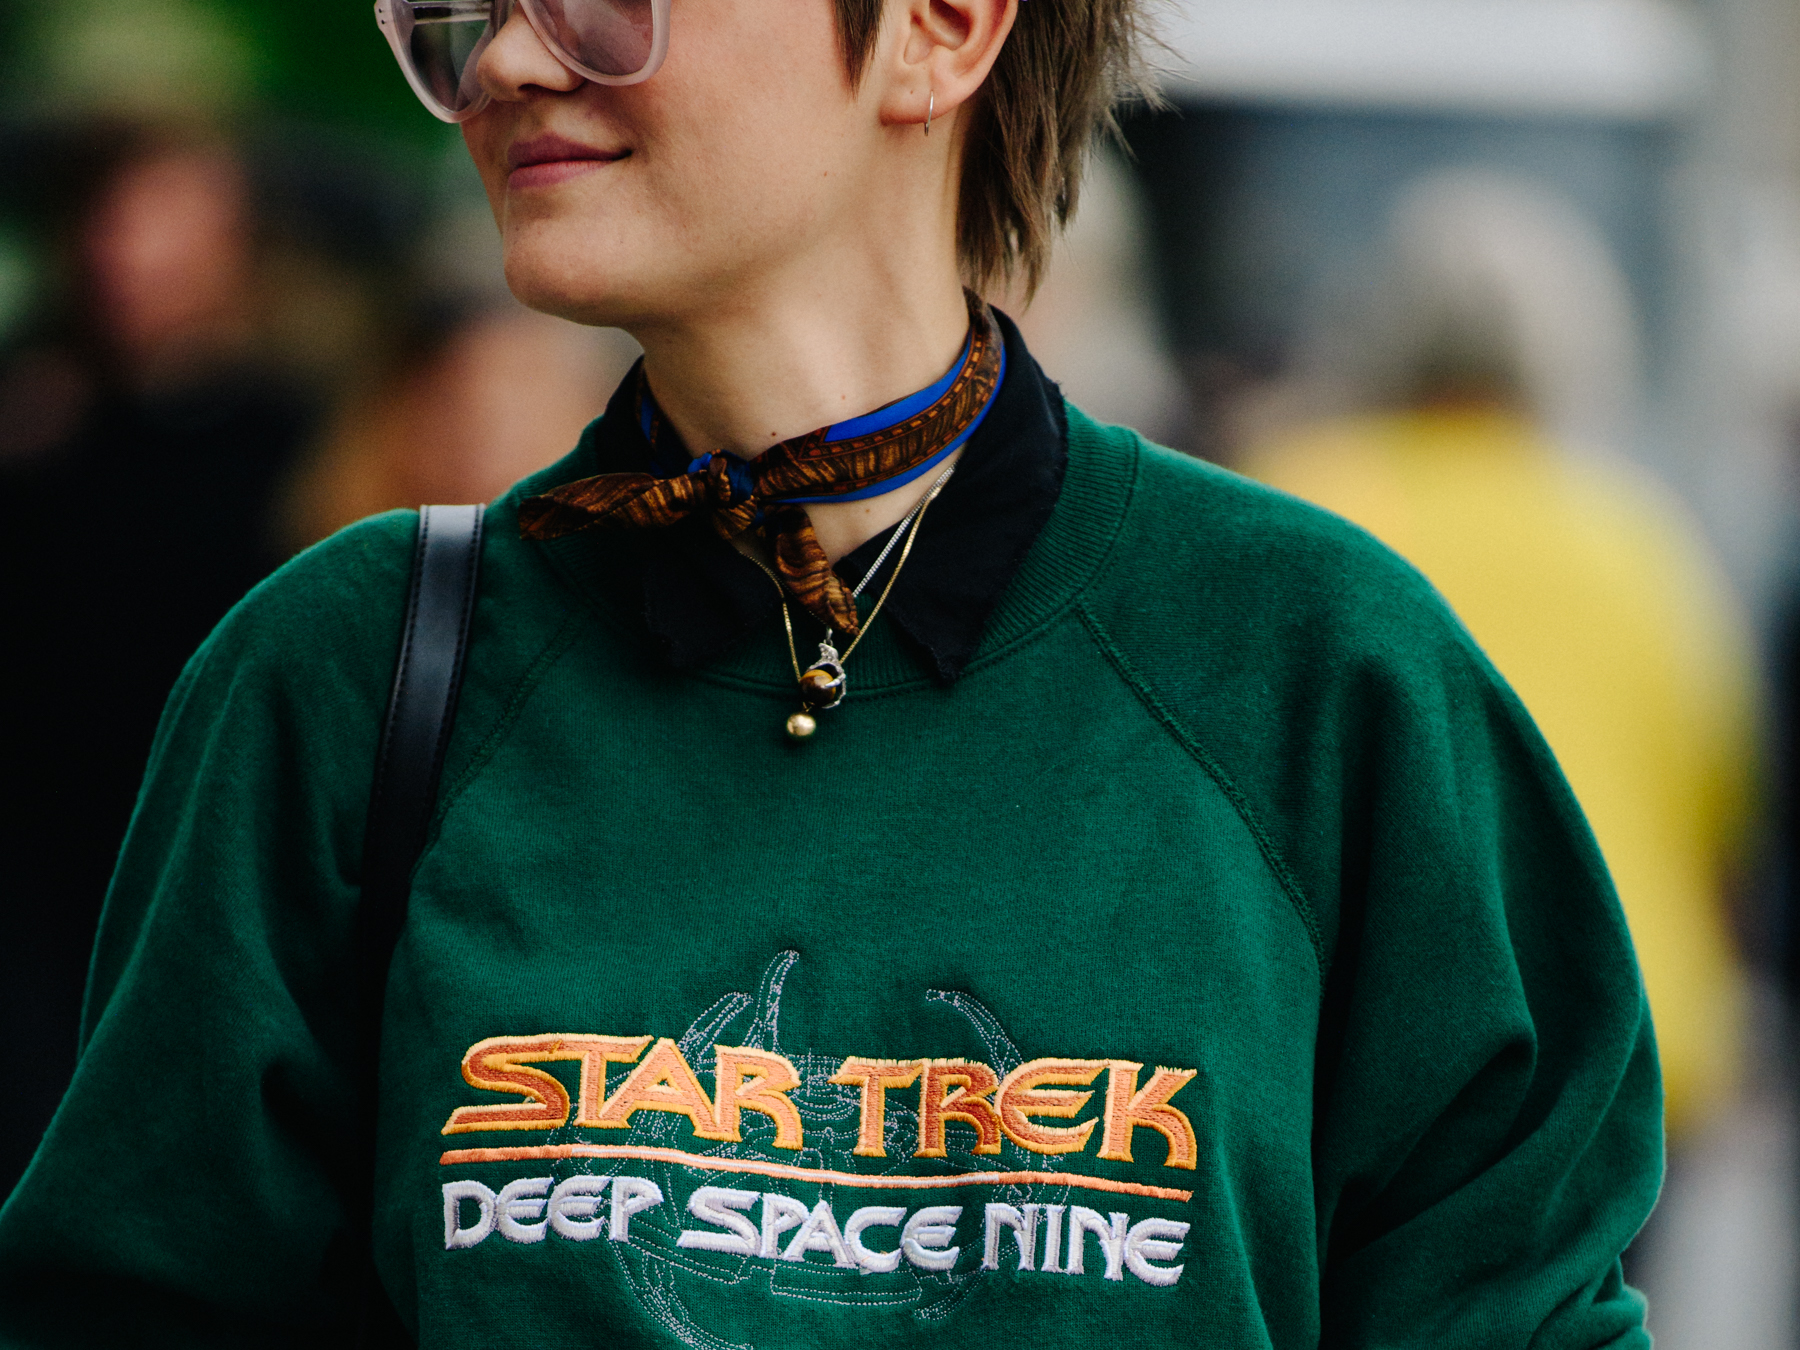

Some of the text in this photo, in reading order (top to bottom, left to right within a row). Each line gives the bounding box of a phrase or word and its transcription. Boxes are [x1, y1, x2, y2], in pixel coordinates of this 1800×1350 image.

[441, 1033, 1198, 1170] STAR TREK
[442, 1175, 1191, 1287] DEEP SPACE NINE
